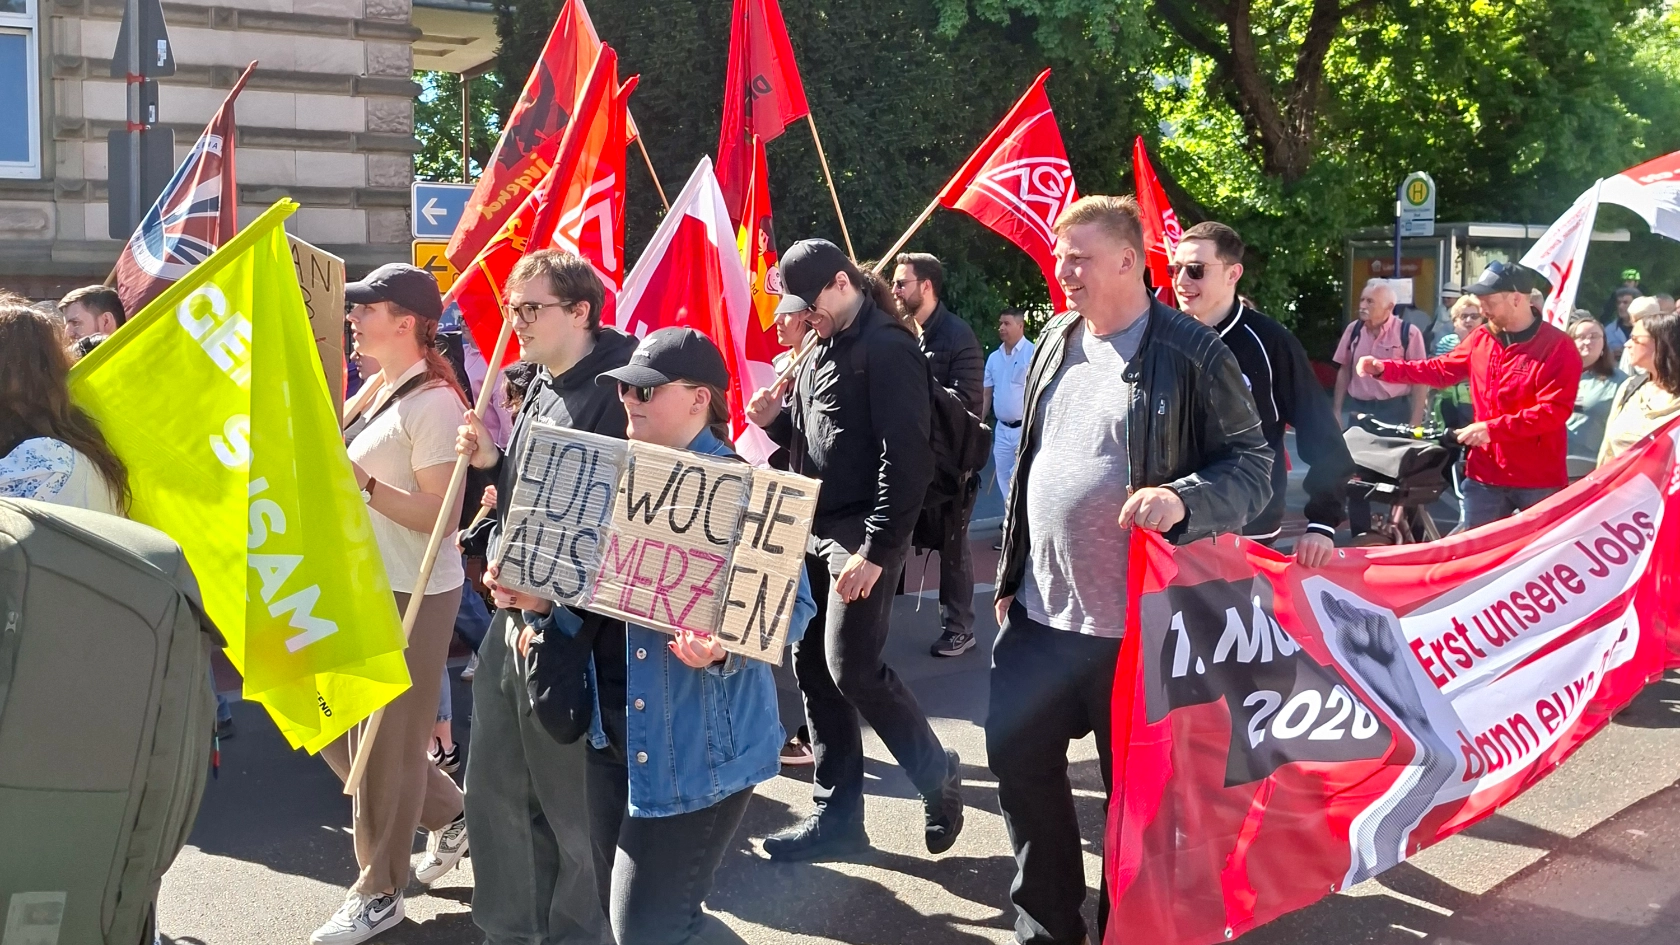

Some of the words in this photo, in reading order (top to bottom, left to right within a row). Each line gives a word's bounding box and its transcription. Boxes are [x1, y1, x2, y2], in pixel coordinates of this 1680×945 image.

[1413, 183, 1423, 200] H
[1409, 616, 1487, 690] Erst
[1472, 563, 1586, 648] unsere
[1574, 511, 1655, 578] Jobs
[1170, 610, 1206, 678] 1.
[317, 690, 333, 717] END
[1456, 712, 1540, 782] dann
[1536, 671, 1595, 736] eur
